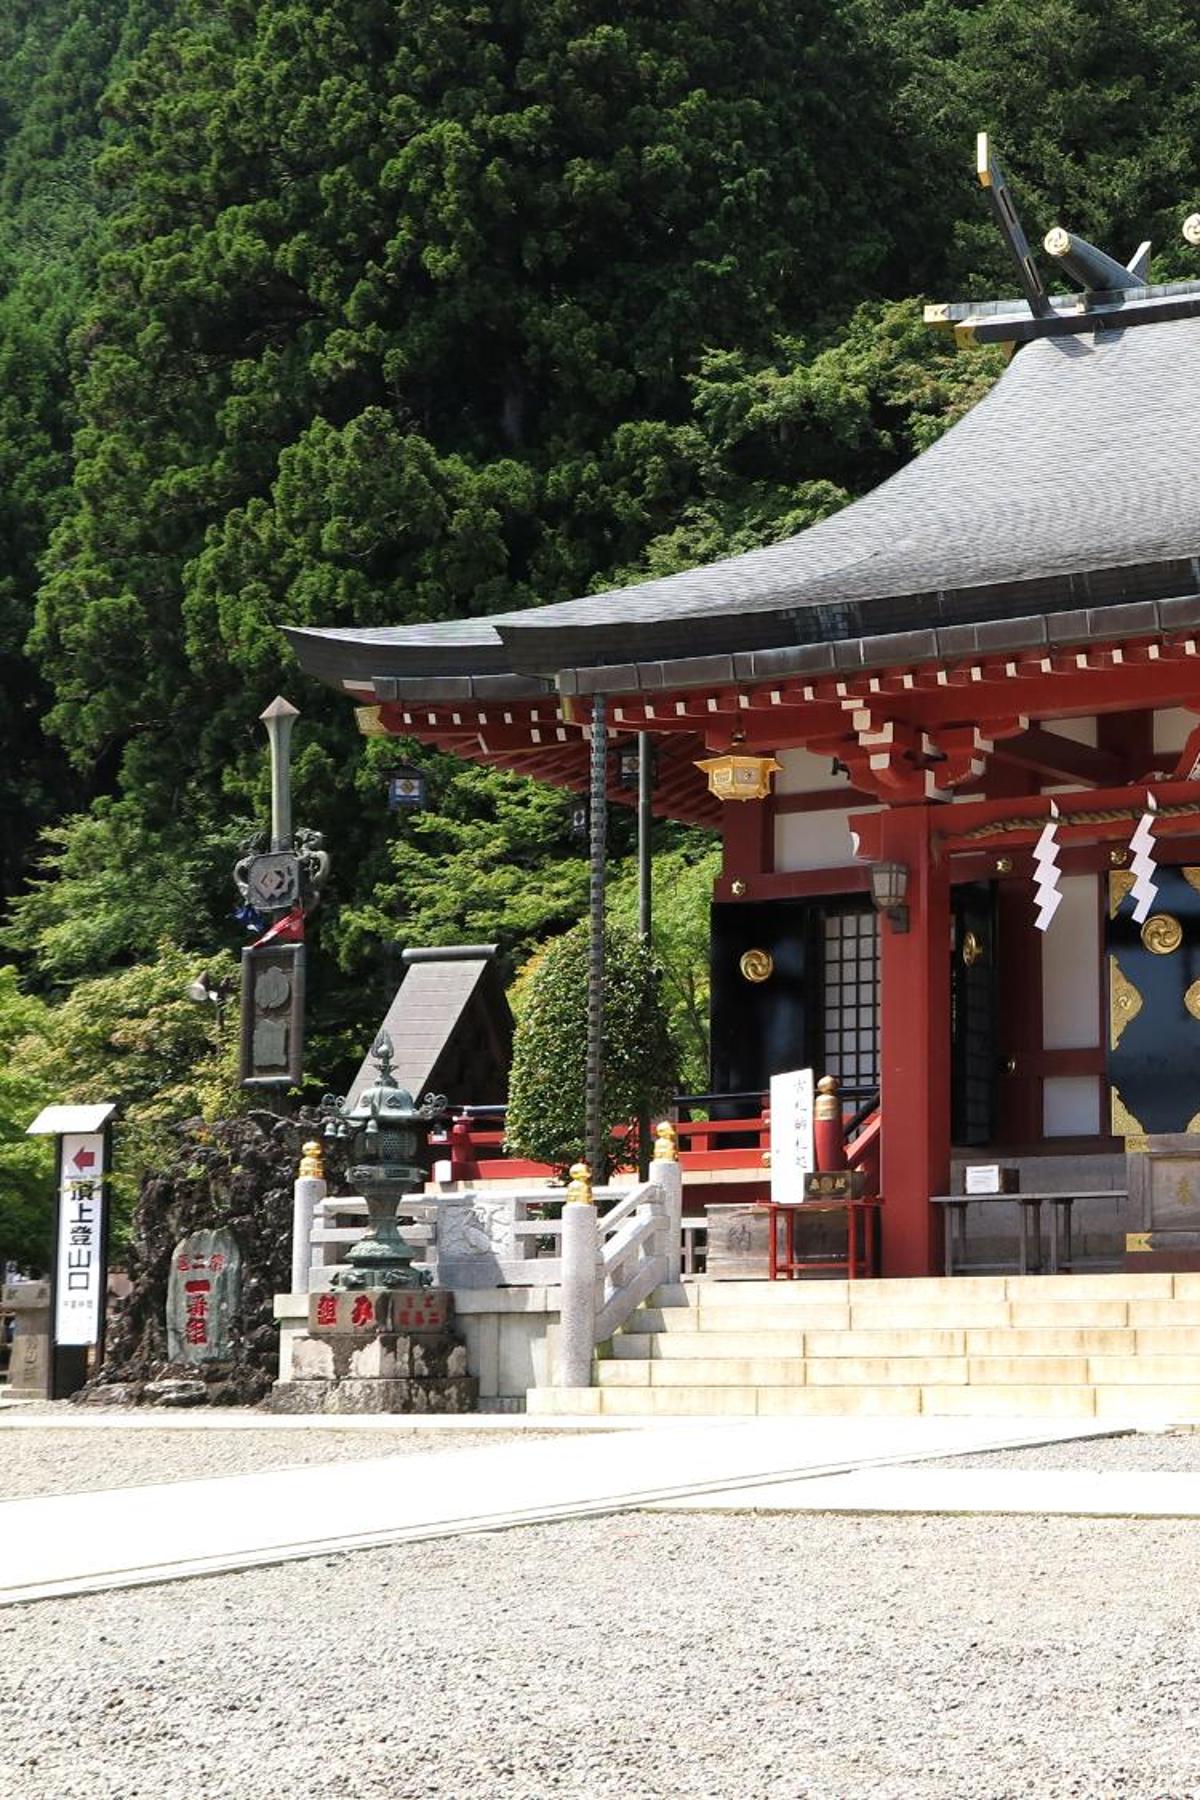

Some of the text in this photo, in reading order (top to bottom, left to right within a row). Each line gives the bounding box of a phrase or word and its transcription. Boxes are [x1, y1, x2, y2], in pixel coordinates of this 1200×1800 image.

[68, 1180, 94, 1291] 頂上登山口
